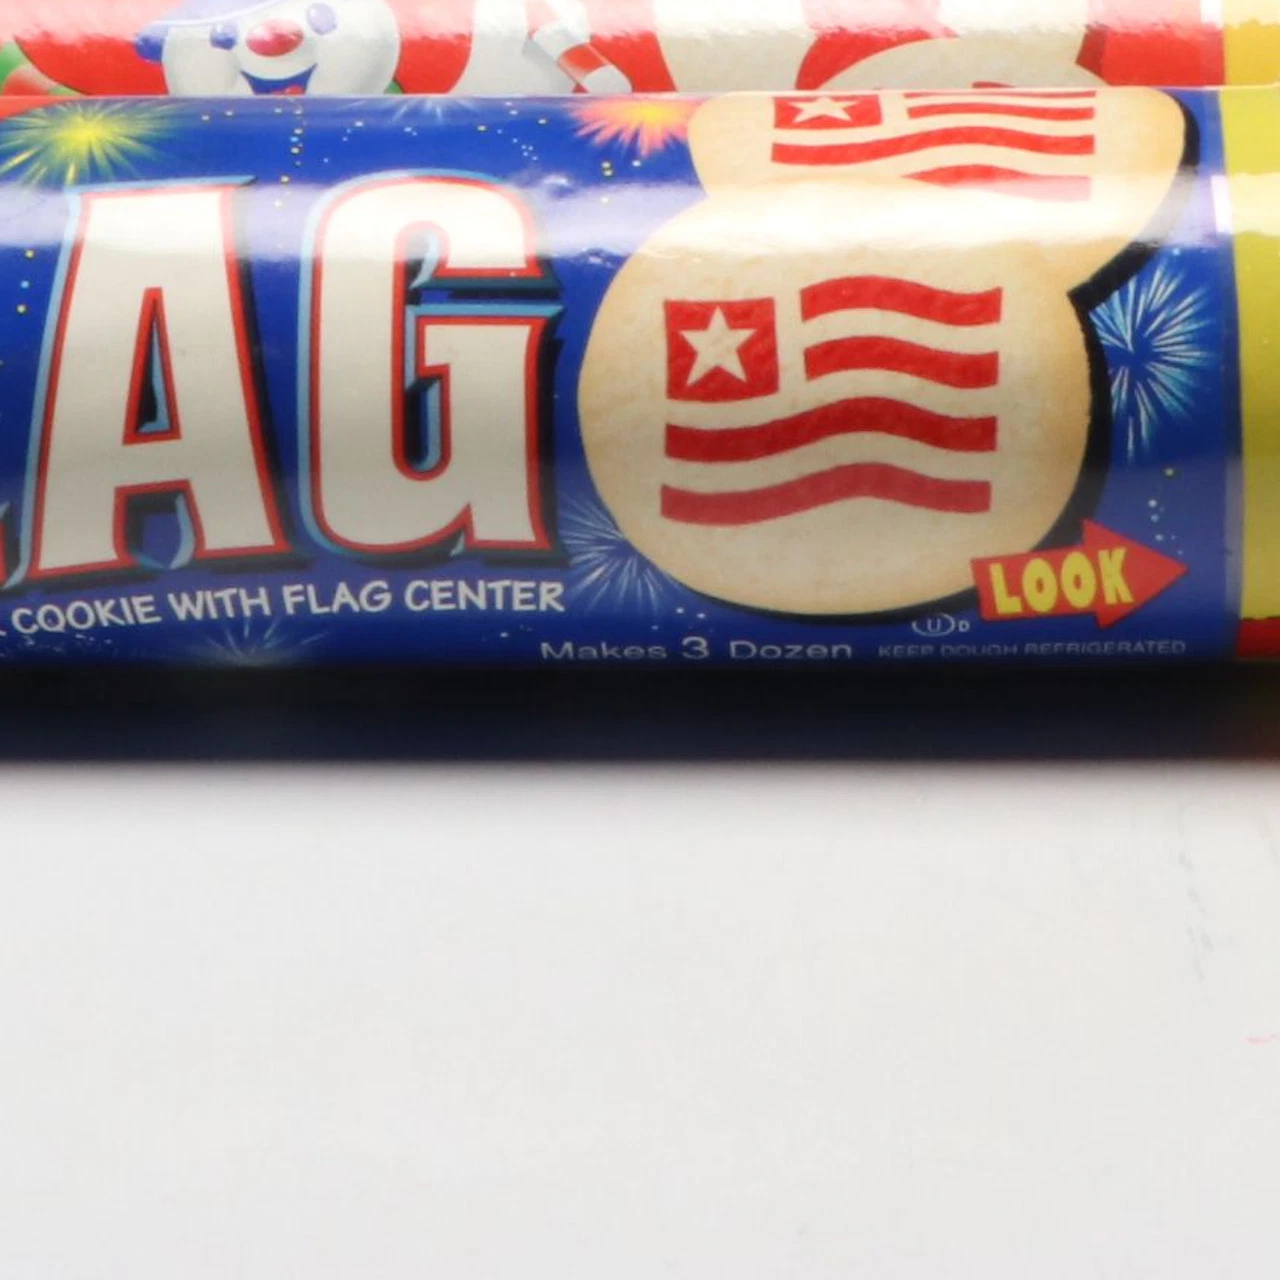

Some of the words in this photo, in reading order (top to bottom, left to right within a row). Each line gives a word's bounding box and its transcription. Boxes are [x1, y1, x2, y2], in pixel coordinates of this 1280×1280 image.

[988, 546, 1135, 616] LOOK
[10, 591, 162, 635] COOKIE
[166, 586, 274, 622] WITH
[282, 580, 393, 616] FLAG
[402, 578, 566, 613] CENTER
[538, 640, 669, 660] Makes
[680, 635, 711, 661] 3
[728, 639, 854, 660] Dozen
[1023, 639, 1187, 656] REFRIGERATED
